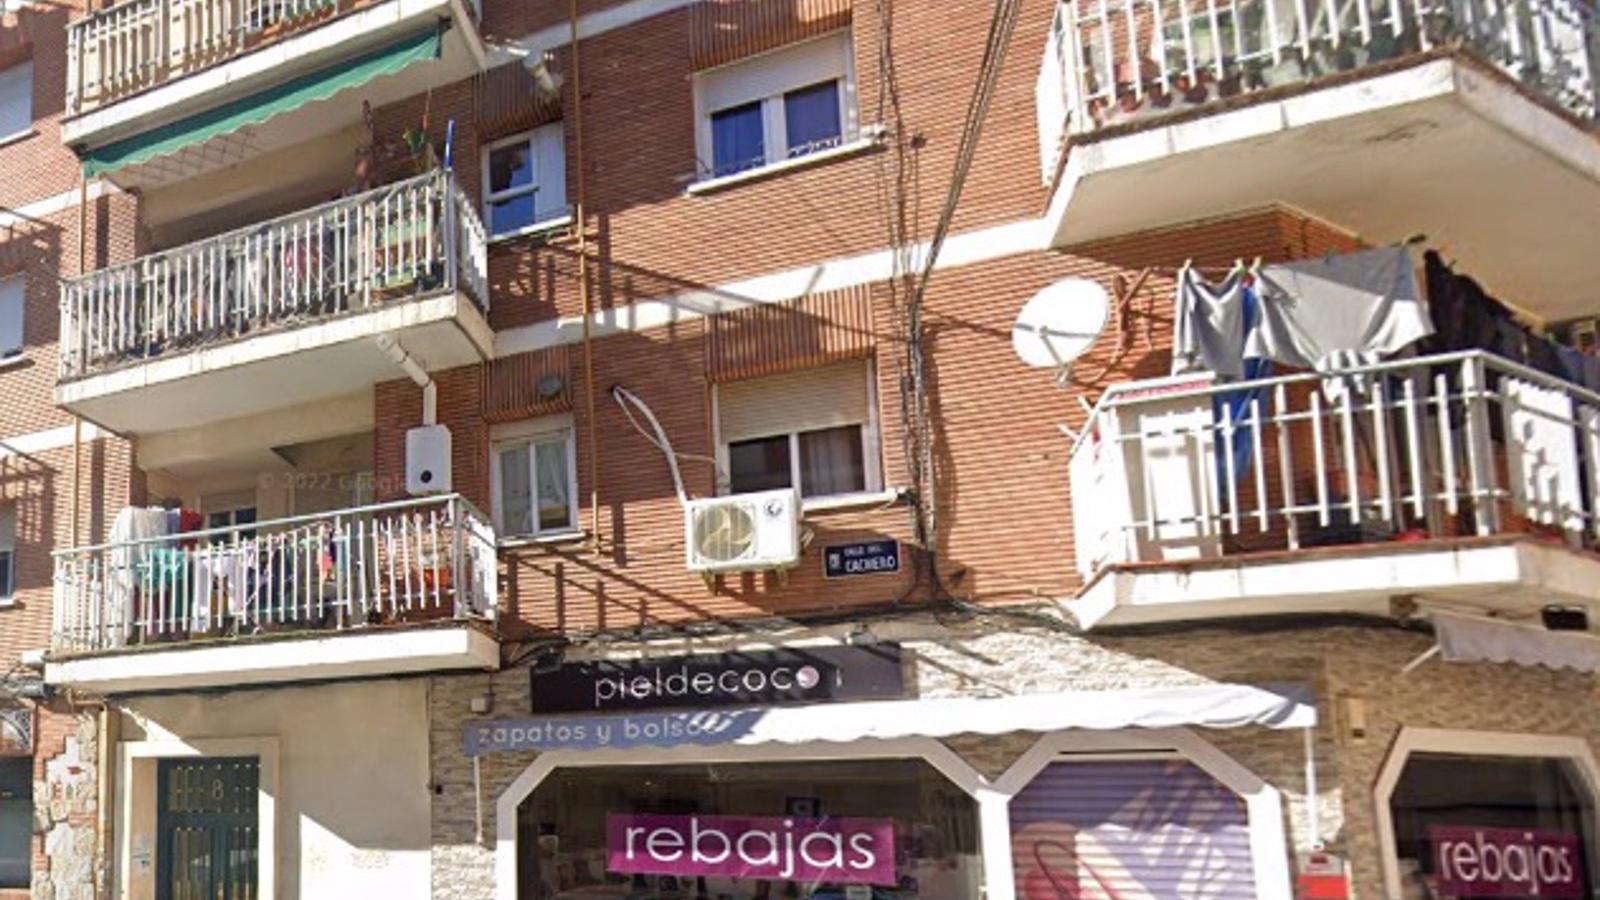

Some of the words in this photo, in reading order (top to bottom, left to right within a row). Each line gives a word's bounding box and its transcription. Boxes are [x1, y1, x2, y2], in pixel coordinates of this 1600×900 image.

[594, 665, 820, 706] pieldecoco
[478, 720, 587, 745] zapatos
[597, 726, 611, 743] y
[211, 778, 225, 800] 8
[625, 817, 876, 878] rebajas
[1439, 831, 1574, 894] rebajas
